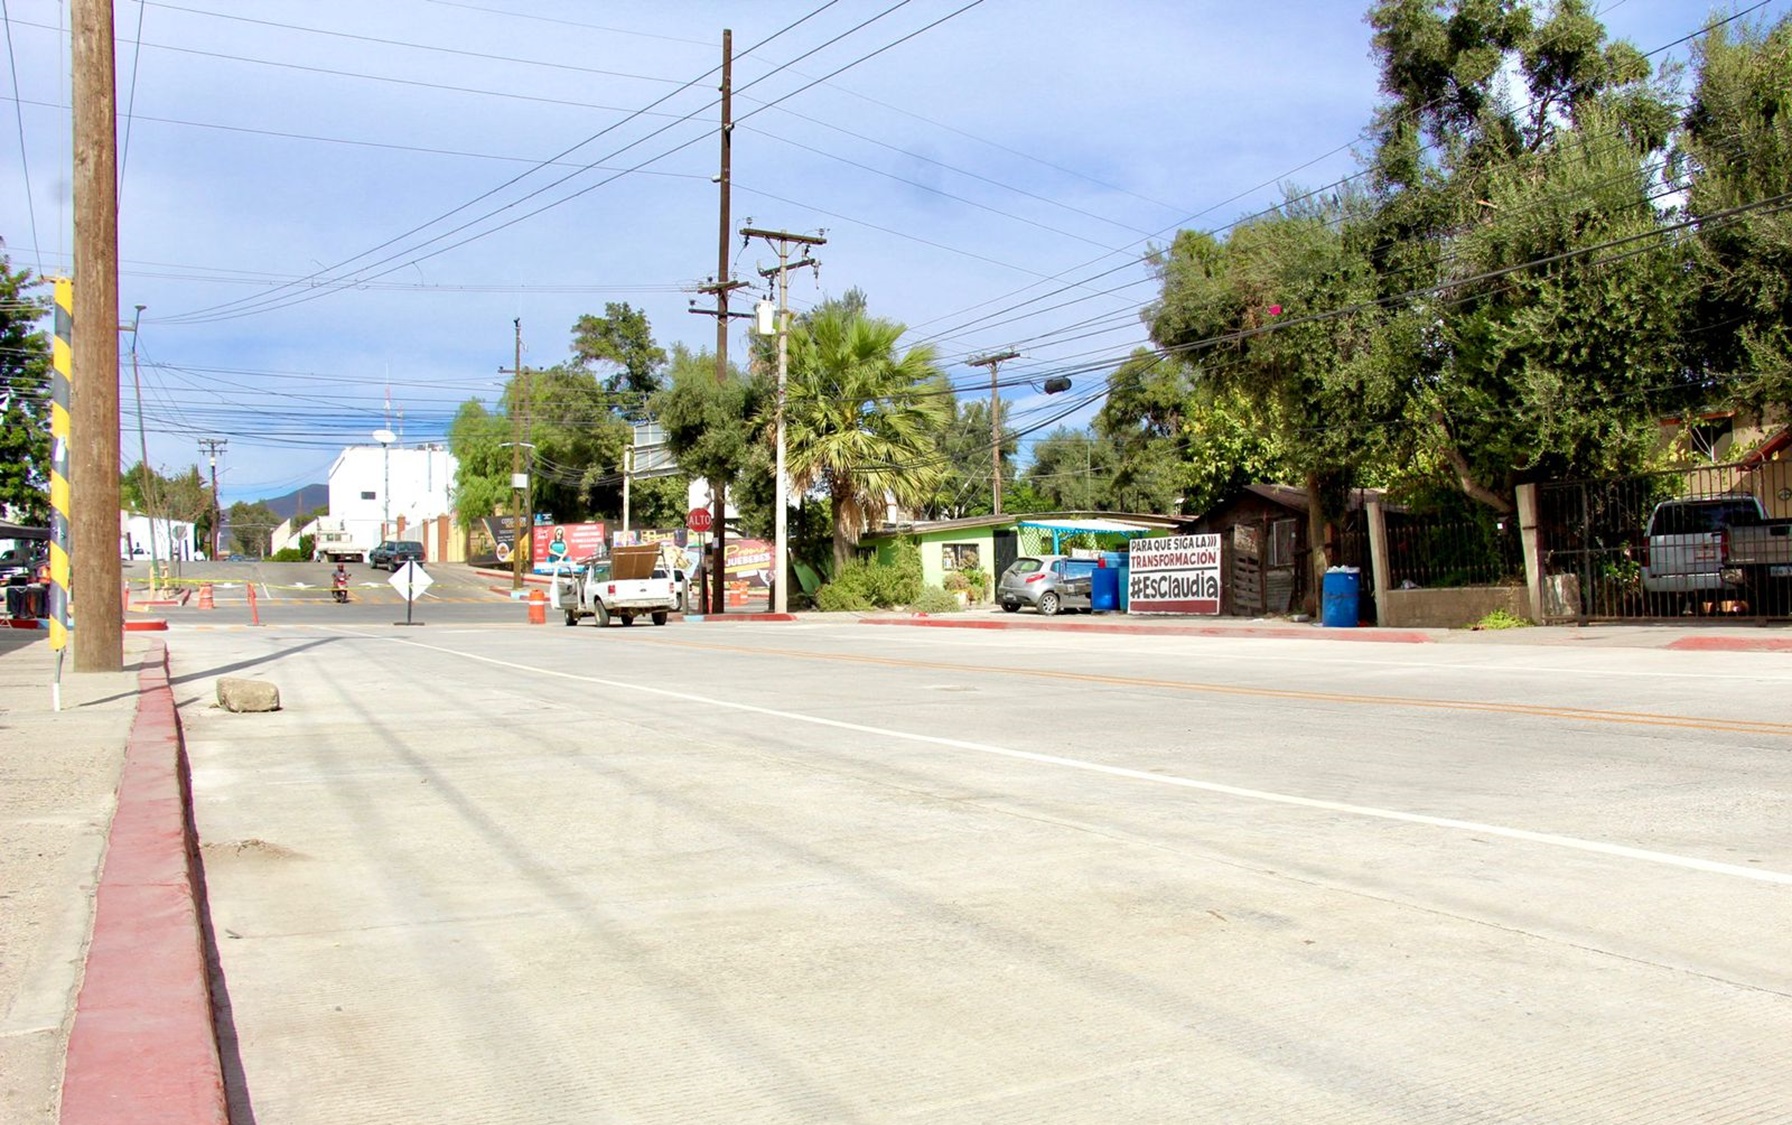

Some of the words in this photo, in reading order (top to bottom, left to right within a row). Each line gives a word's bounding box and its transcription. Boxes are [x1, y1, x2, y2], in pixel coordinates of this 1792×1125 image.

[689, 515, 711, 525] ALTO
[1131, 539, 1152, 552] PARA
[1154, 538, 1172, 551] QUE
[1175, 537, 1194, 551] SIGA
[1196, 536, 1206, 549] LA
[1131, 549, 1216, 568] TRANSFORMACIÓN
[1130, 571, 1218, 599] #EsClaudia
